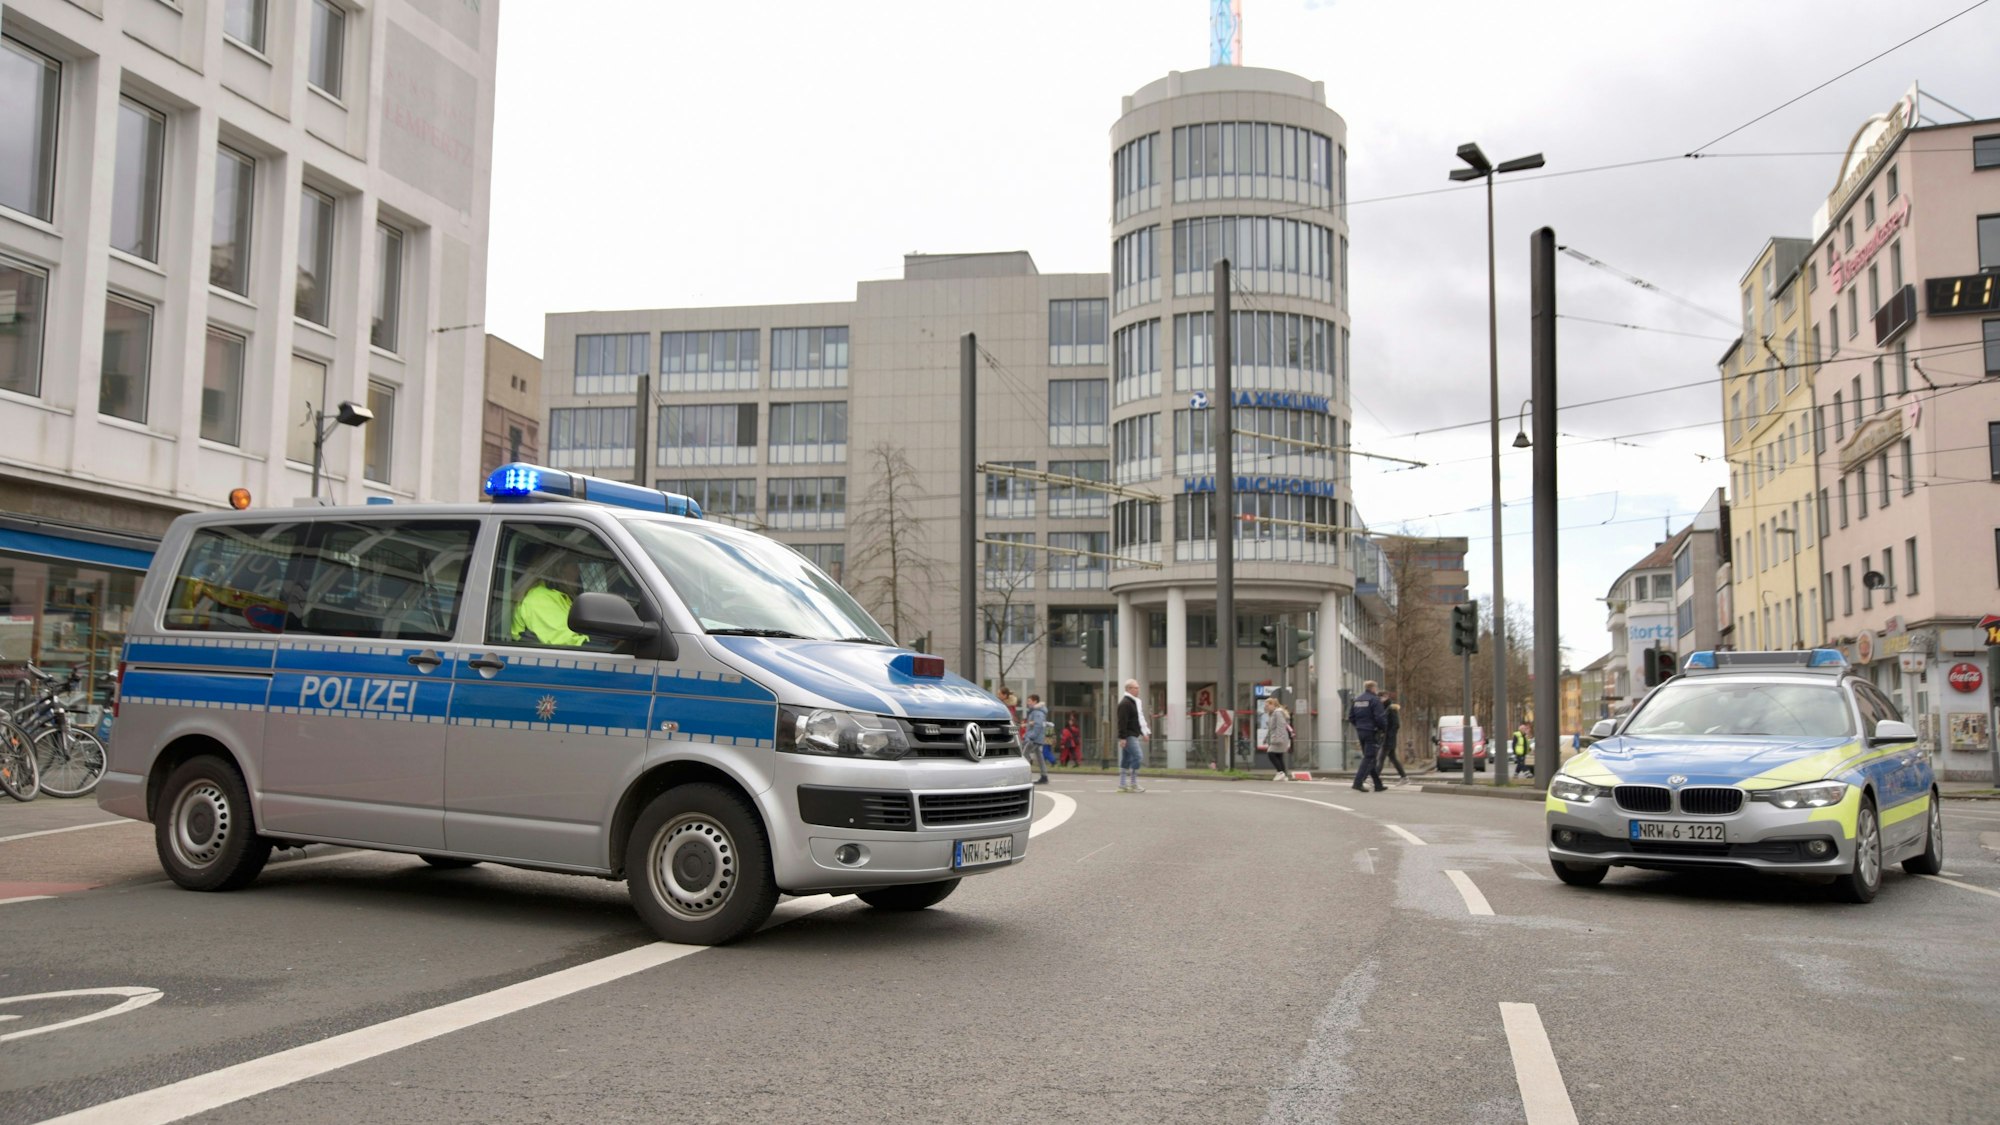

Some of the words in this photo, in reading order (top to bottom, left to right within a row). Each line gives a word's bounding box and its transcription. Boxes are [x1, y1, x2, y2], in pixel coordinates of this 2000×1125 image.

[1231, 389, 1330, 413] AXISKLINIK
[299, 675, 418, 713] POLIZEI
[1639, 823, 1664, 838] NRW
[1672, 824, 1723, 840] 6-1212
[962, 843, 980, 863] NRW
[984, 839, 1011, 860] 5-4644
